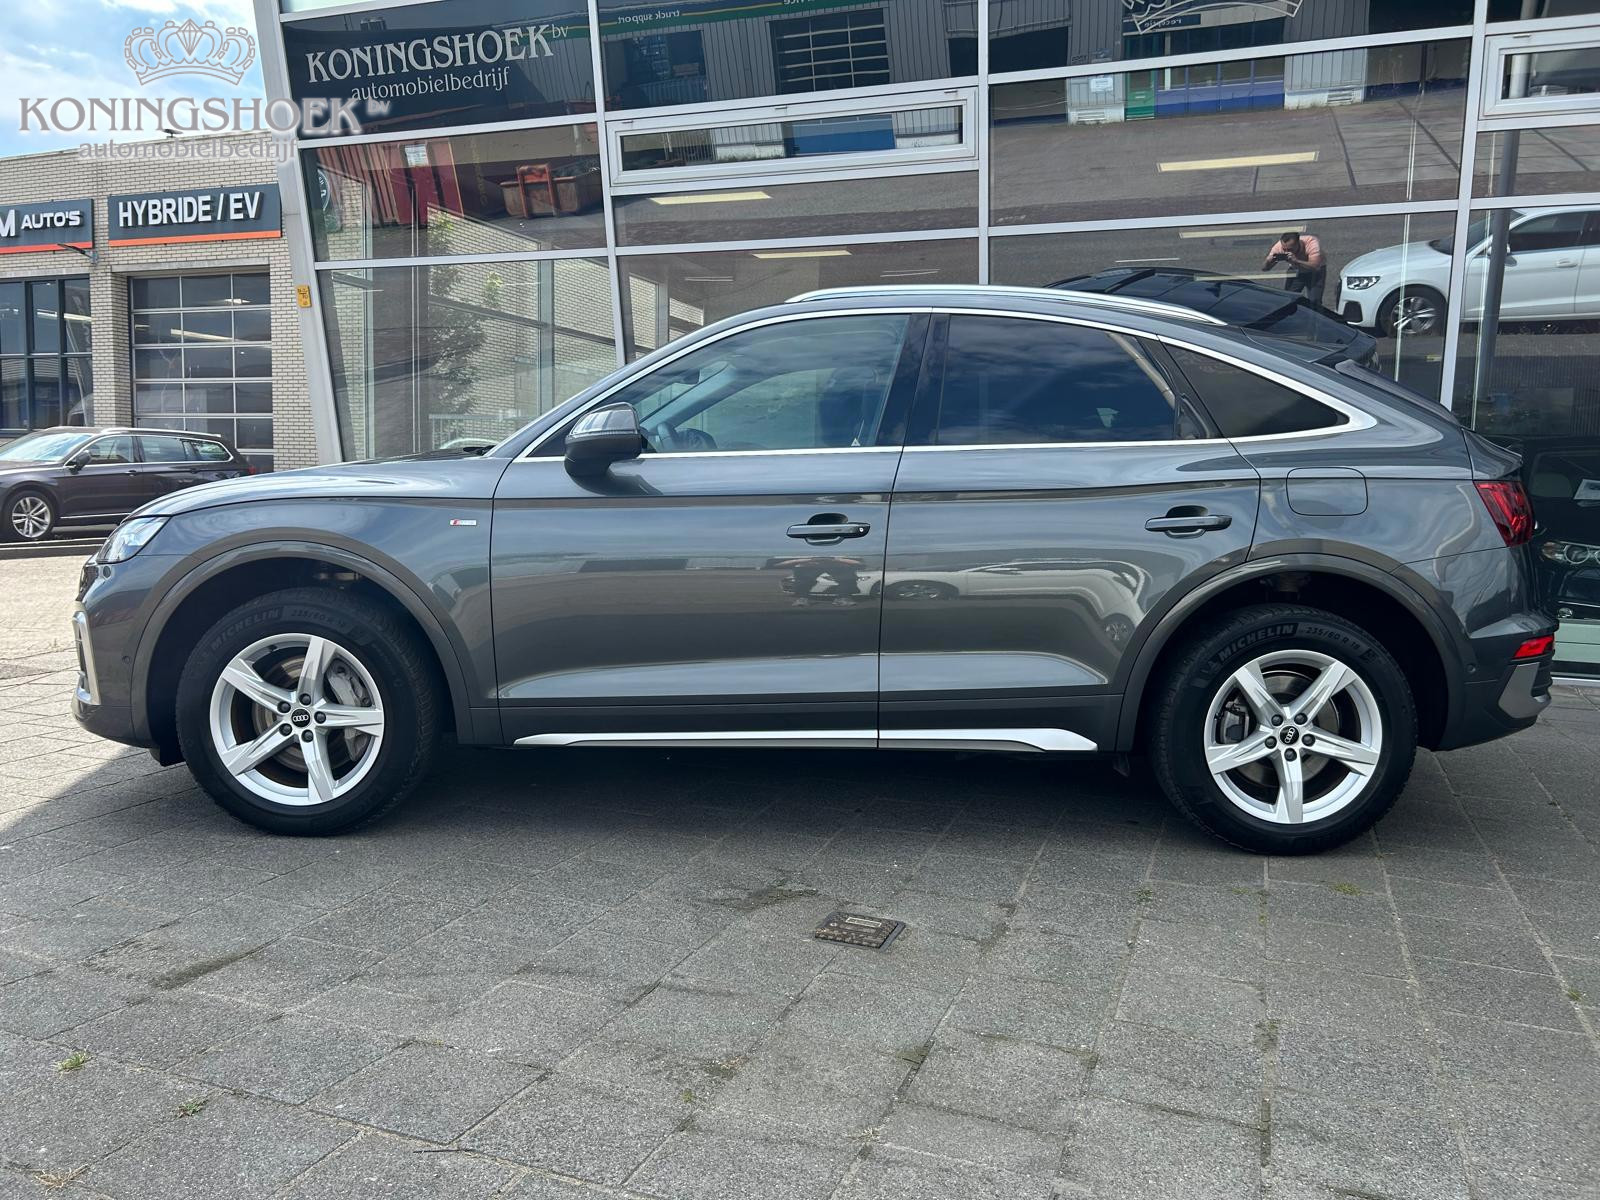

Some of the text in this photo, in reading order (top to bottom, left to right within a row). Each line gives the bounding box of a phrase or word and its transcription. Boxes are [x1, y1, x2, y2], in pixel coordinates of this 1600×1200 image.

[305, 23, 569, 83] KONINGSHOEK bv
[351, 66, 510, 101] automobielbedrijf
[21, 210, 81, 230] AUTO'S
[118, 195, 212, 227] HYBRIDE
[229, 191, 261, 219] EV
[210, 608, 280, 650] MICHELIN
[1218, 624, 1295, 662] MICHELIN
